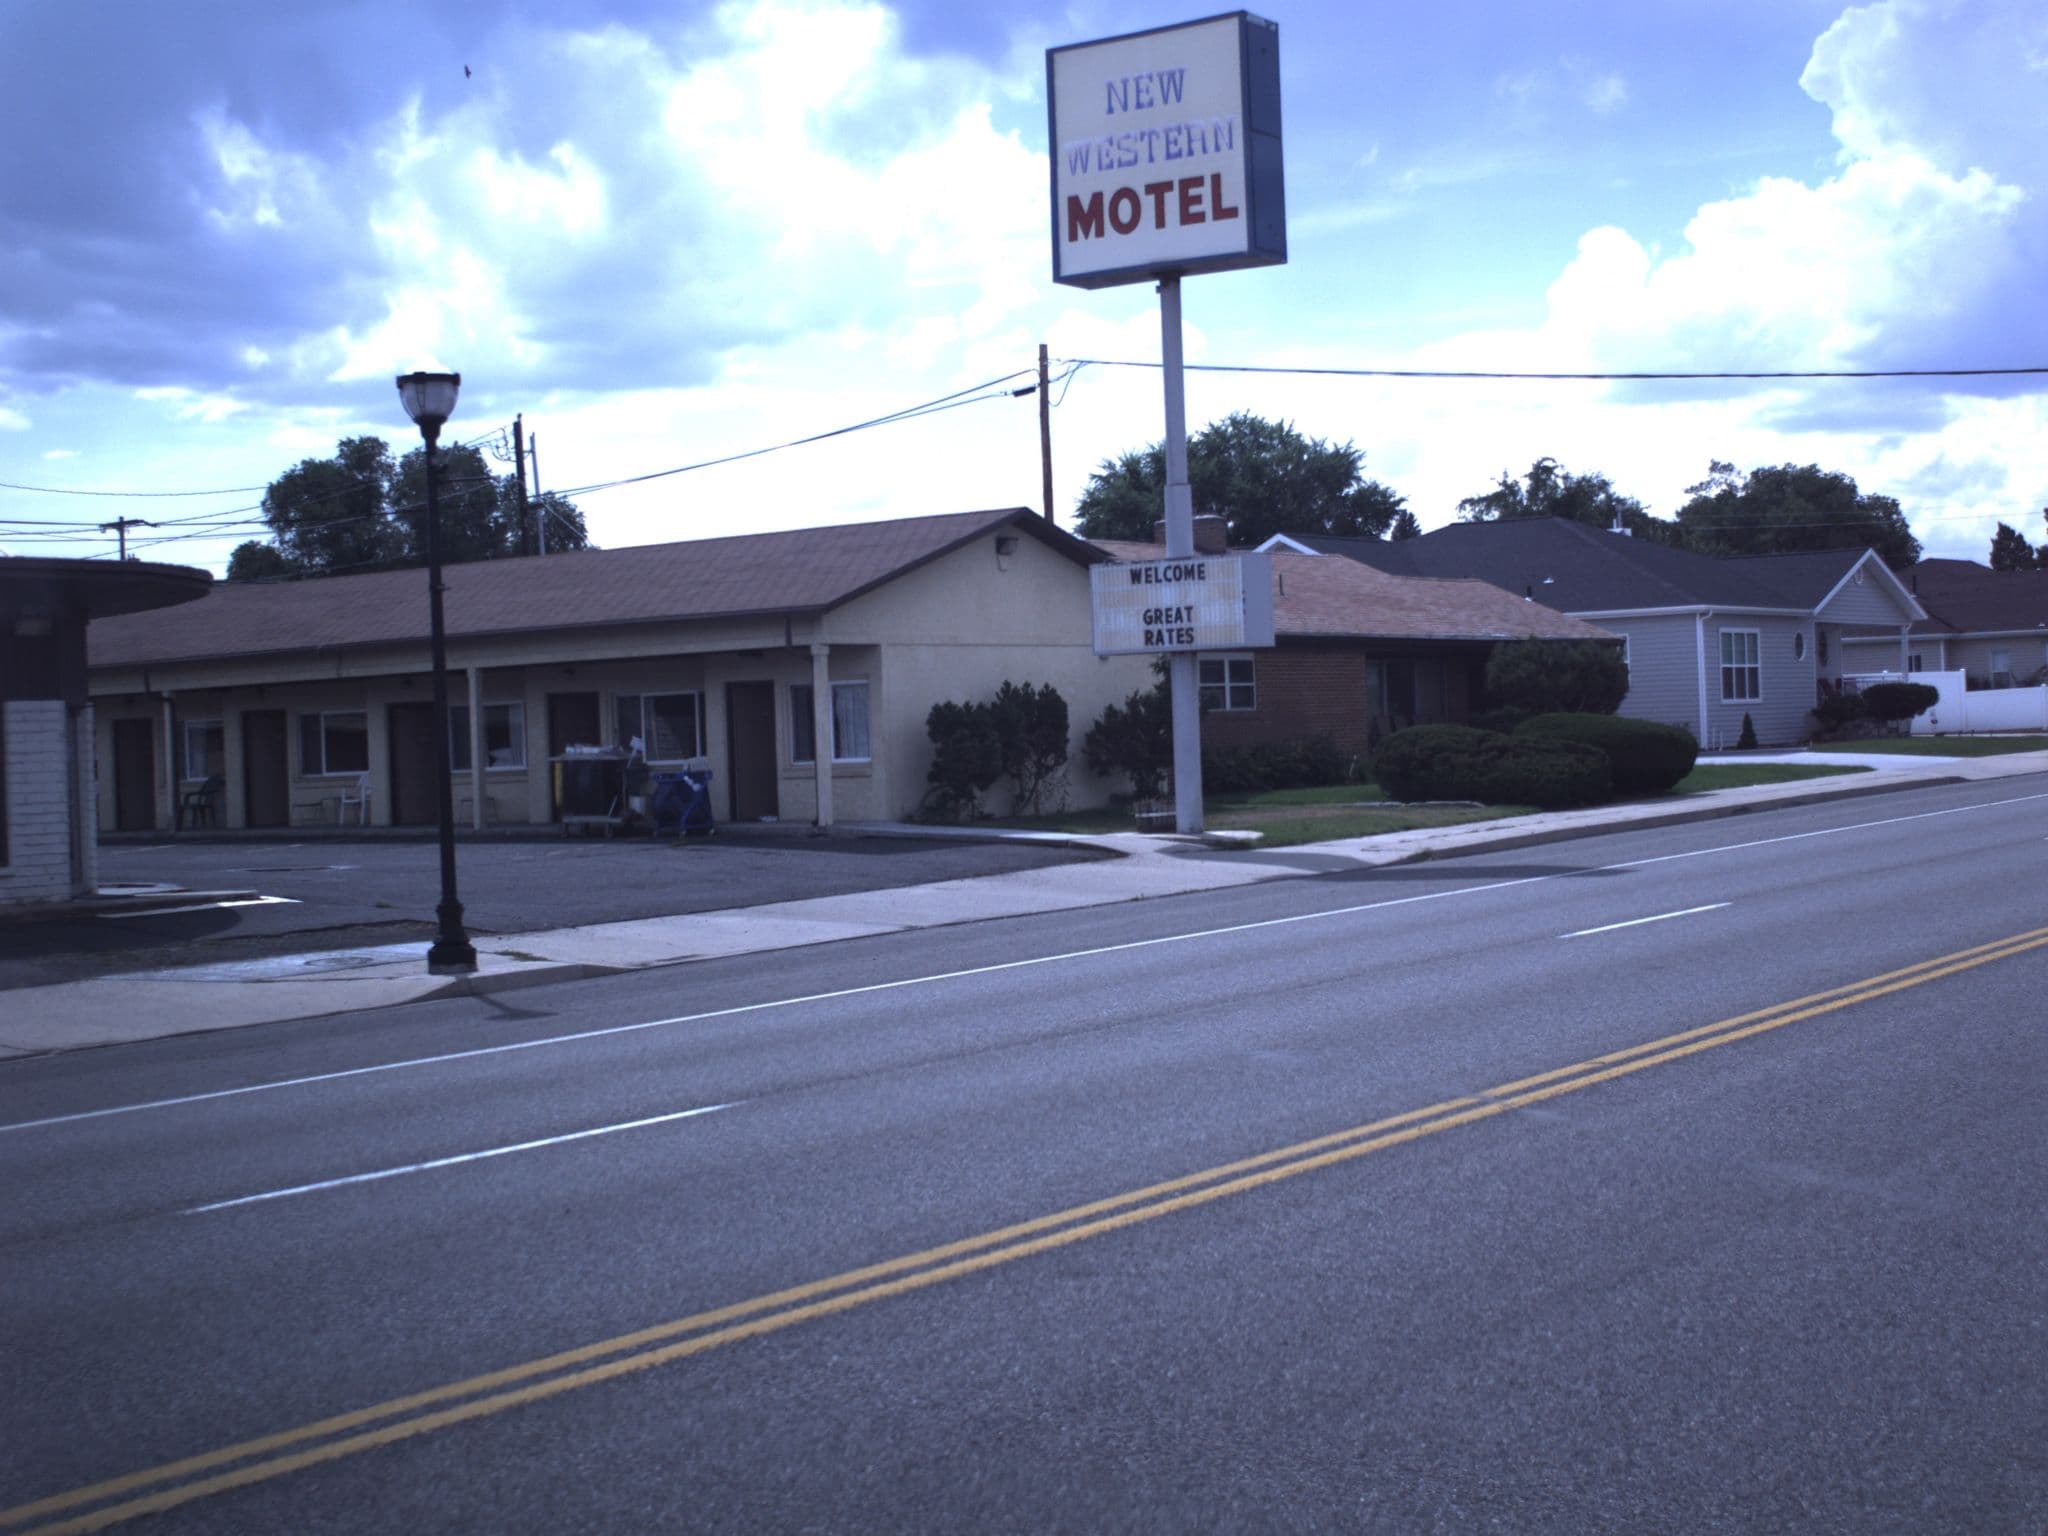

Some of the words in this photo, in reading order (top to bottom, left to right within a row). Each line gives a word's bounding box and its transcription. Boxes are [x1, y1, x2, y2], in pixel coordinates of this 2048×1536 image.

[1106, 67, 1187, 114] NEW
[1066, 116, 1236, 176] WESTERN
[1067, 172, 1239, 242] MOTEL
[1129, 562, 1206, 585] WELCOME
[1143, 605, 1194, 626] GREAT
[1144, 627, 1194, 647] RATES
